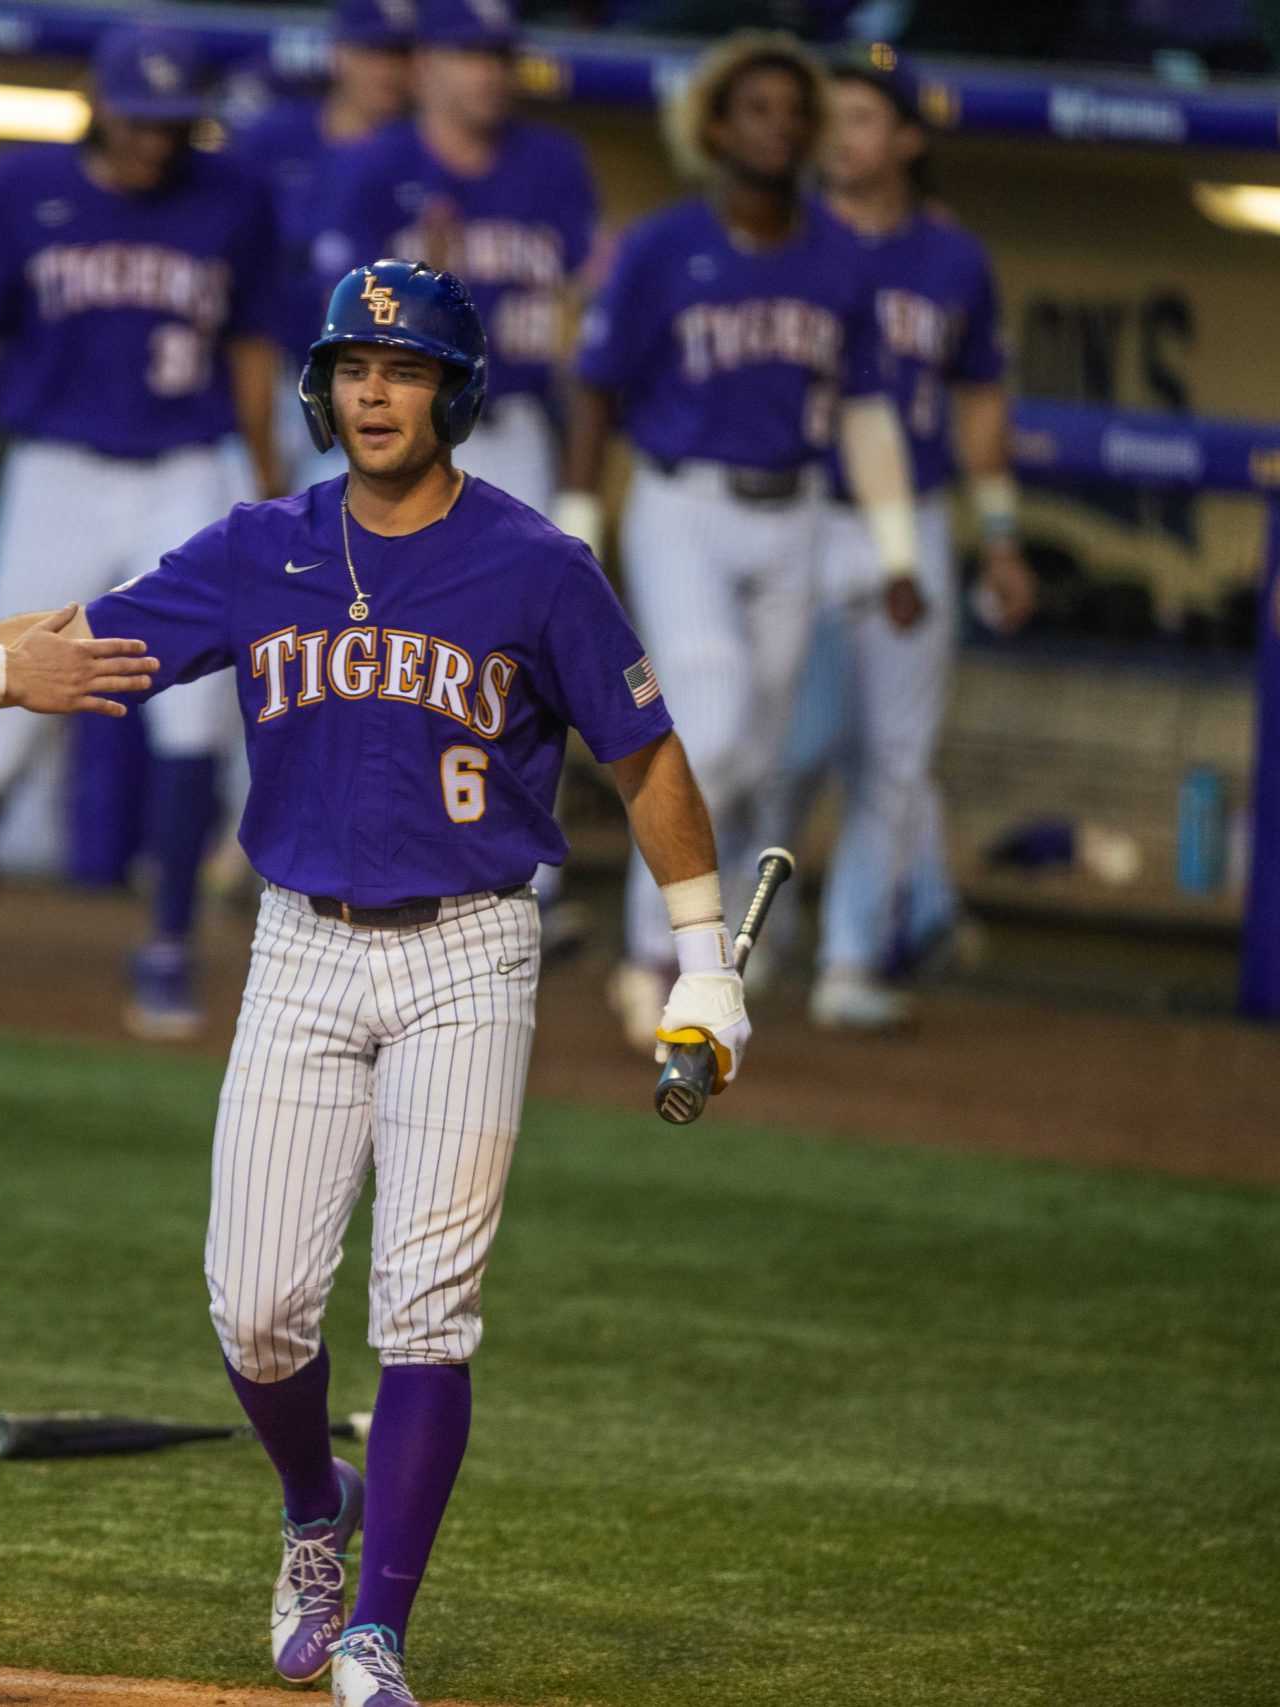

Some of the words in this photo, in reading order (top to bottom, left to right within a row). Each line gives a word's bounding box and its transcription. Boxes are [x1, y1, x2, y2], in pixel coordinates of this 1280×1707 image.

[360, 275, 400, 325] LSU
[250, 624, 518, 740] TIGERS
[439, 744, 489, 824] 6
[296, 1613, 343, 1664] VAPOR
